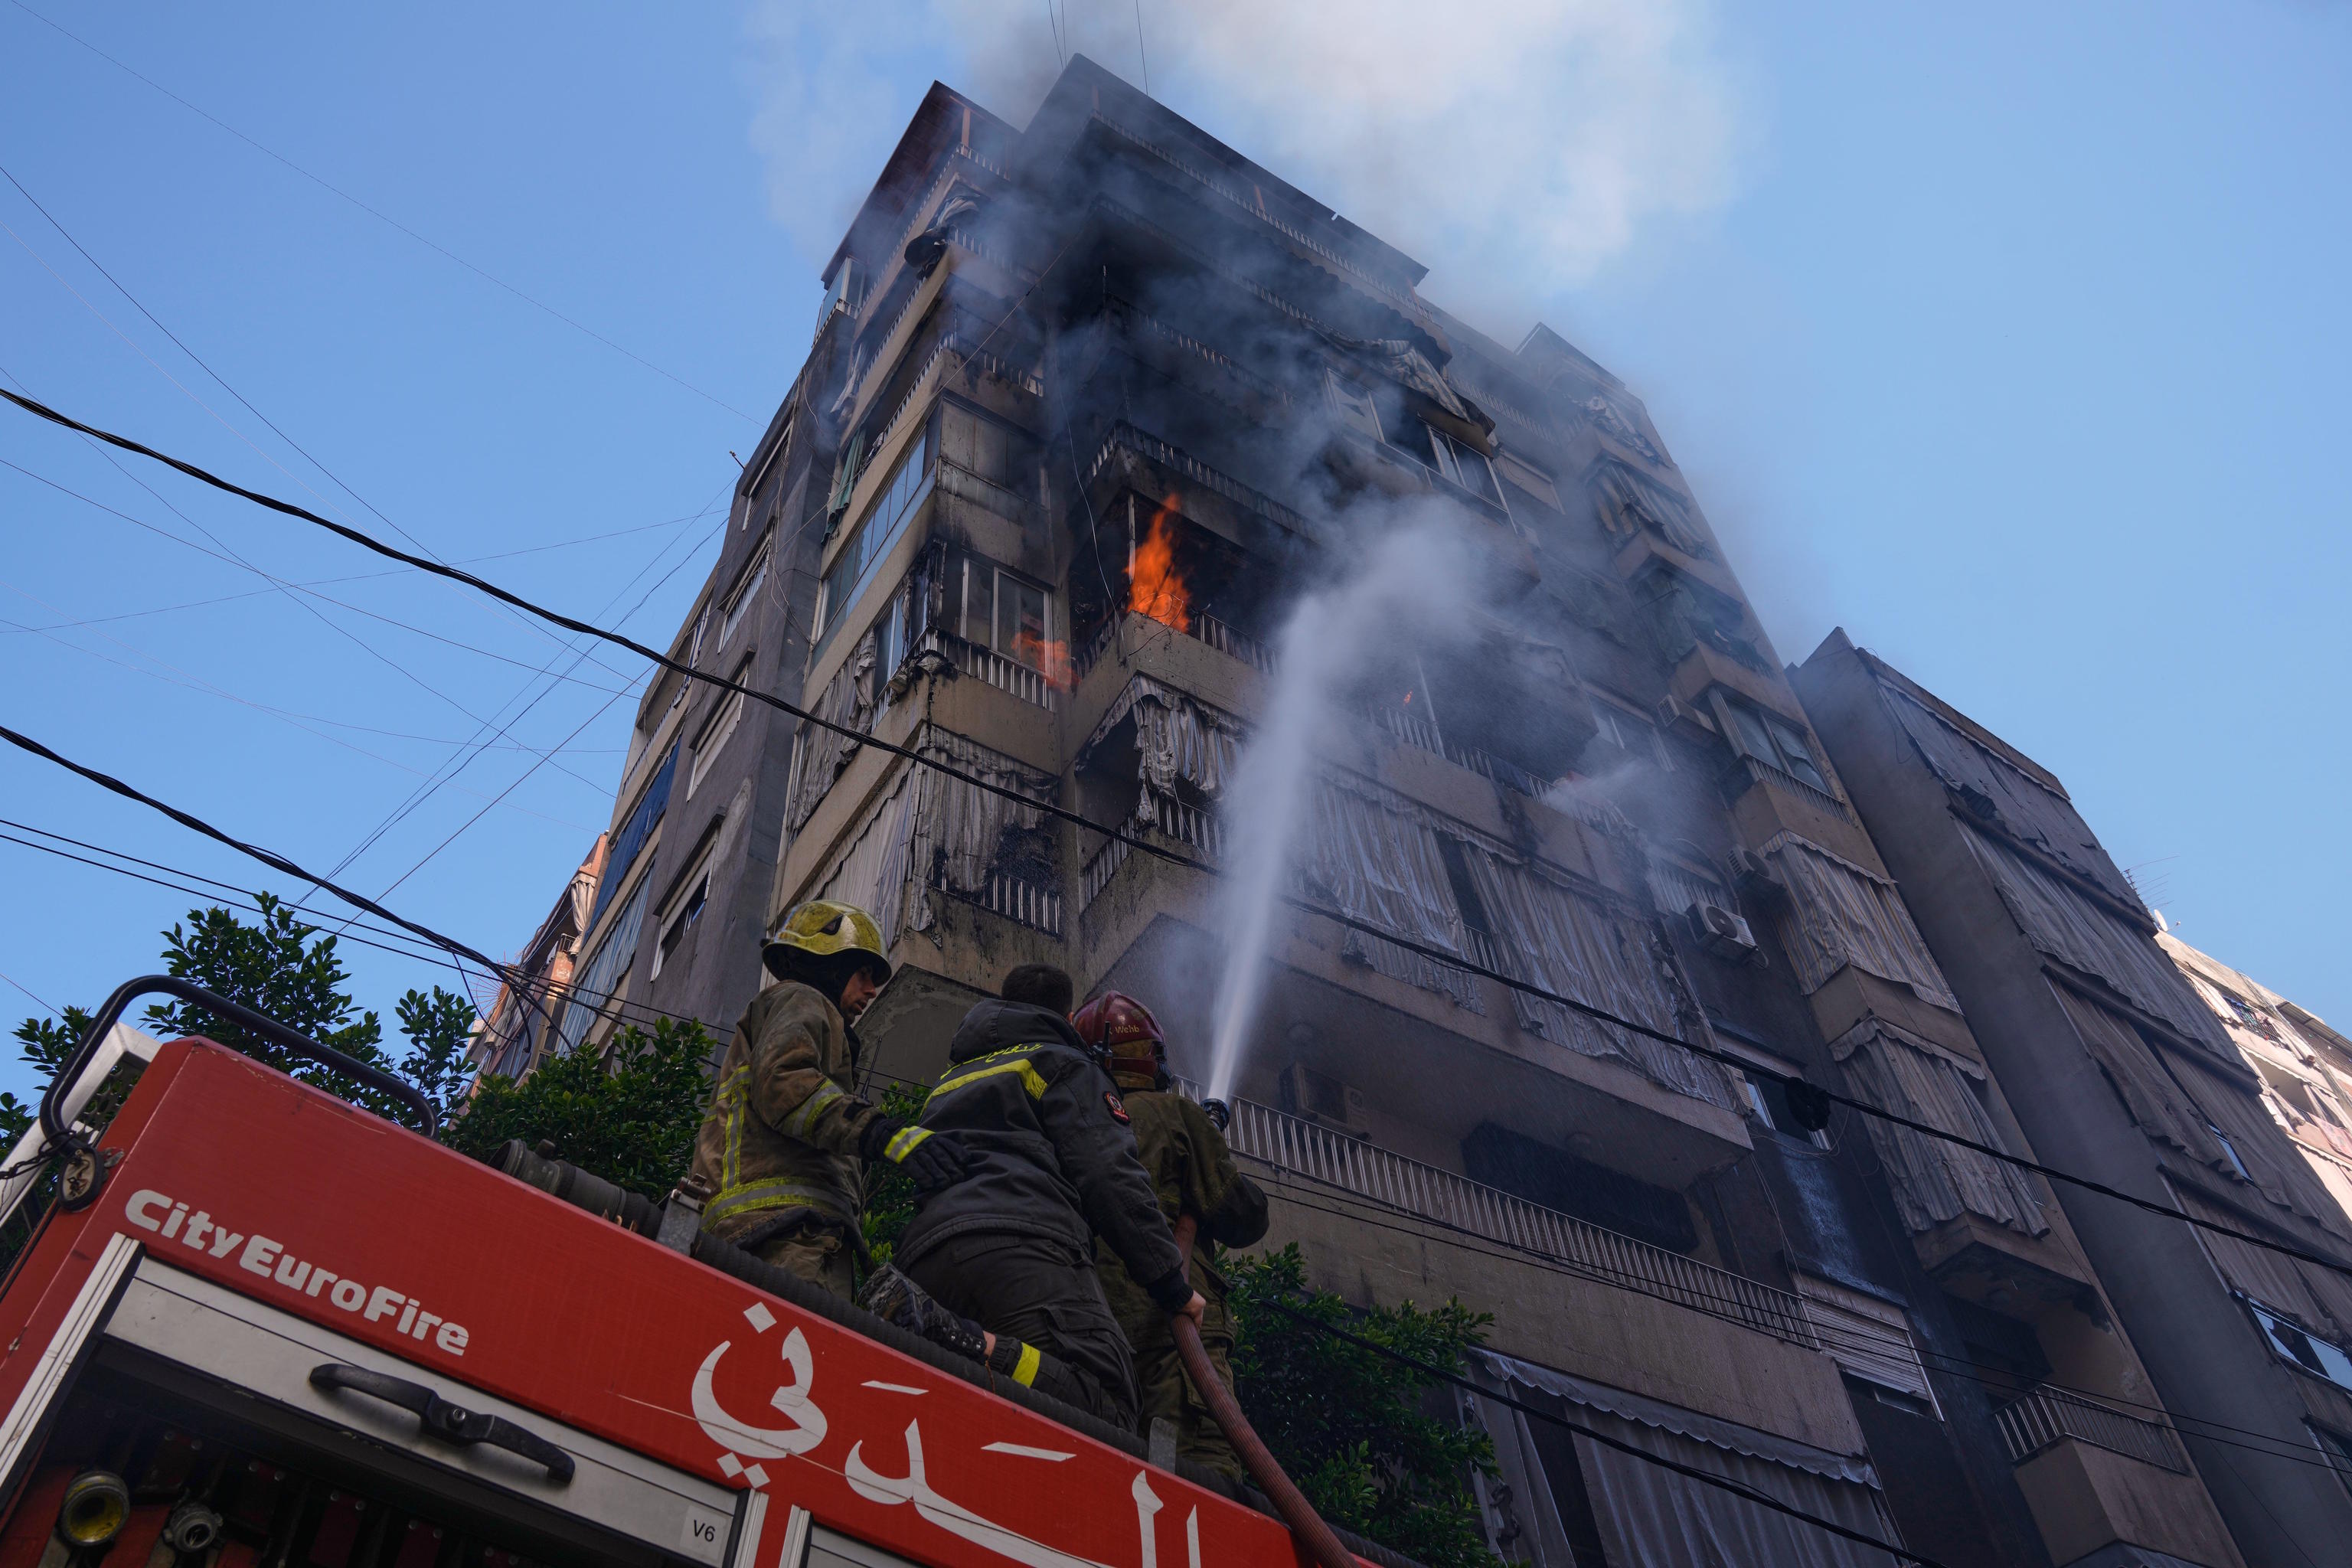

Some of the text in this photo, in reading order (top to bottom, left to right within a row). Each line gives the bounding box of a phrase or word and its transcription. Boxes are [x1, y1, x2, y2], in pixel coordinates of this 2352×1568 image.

[125, 1189, 469, 1356] CityEuroFire
[691, 1301, 1202, 1568] الدني
[694, 1519, 716, 1542] V6
